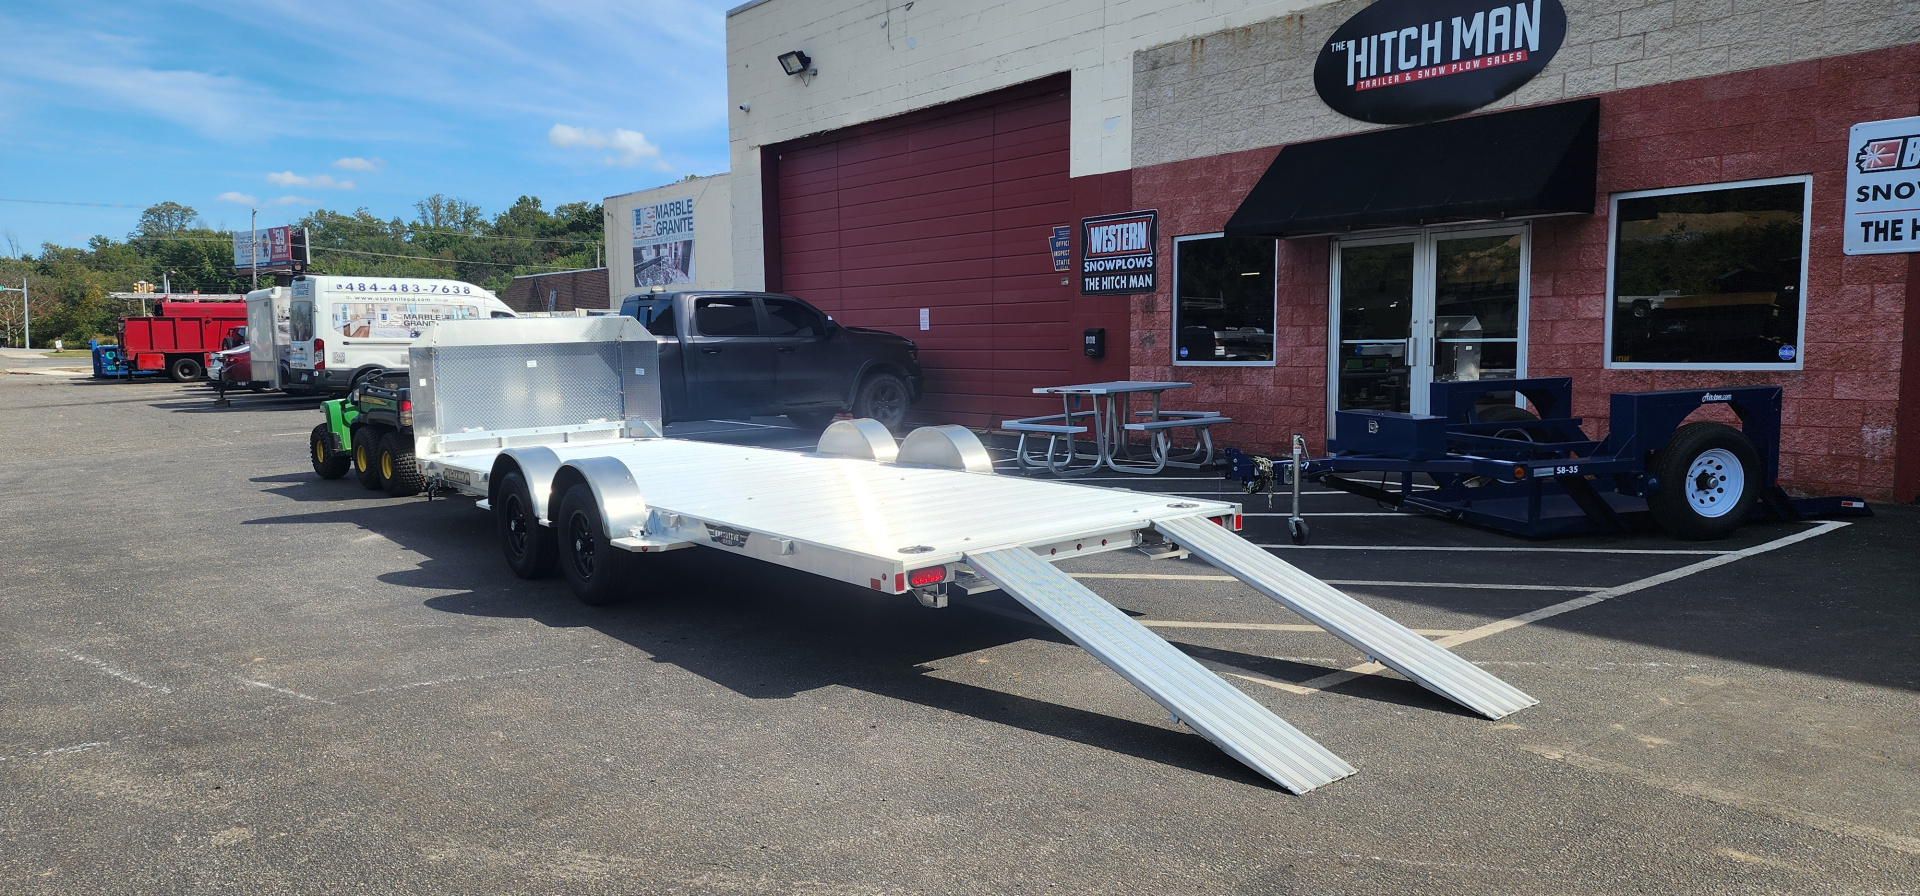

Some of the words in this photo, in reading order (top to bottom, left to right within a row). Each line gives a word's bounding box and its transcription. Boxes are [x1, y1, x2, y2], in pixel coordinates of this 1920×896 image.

[1331, 40, 1346, 52] THE
[1346, 20, 1443, 86] HITCH
[1451, 0, 1541, 60] MAN
[1360, 73, 1400, 90] TRAILER
[1405, 72, 1412, 81] &
[1417, 66, 1446, 79] SNOW
[1451, 59, 1480, 73] PLOW
[1486, 51, 1523, 66] SALES
[1855, 181, 1920, 203] SNO
[656, 199, 693, 219] MARBLE
[656, 216, 693, 236] GRANITE
[1861, 218, 1904, 243] THE
[1091, 221, 1147, 254] WESTERN
[1084, 256, 1153, 272] SNOWPLOWS
[345, 282, 471, 294] 484-483-7638
[1085, 277, 1100, 291] THE
[1102, 275, 1127, 290] HITCH
[1129, 274, 1152, 288] MAN
